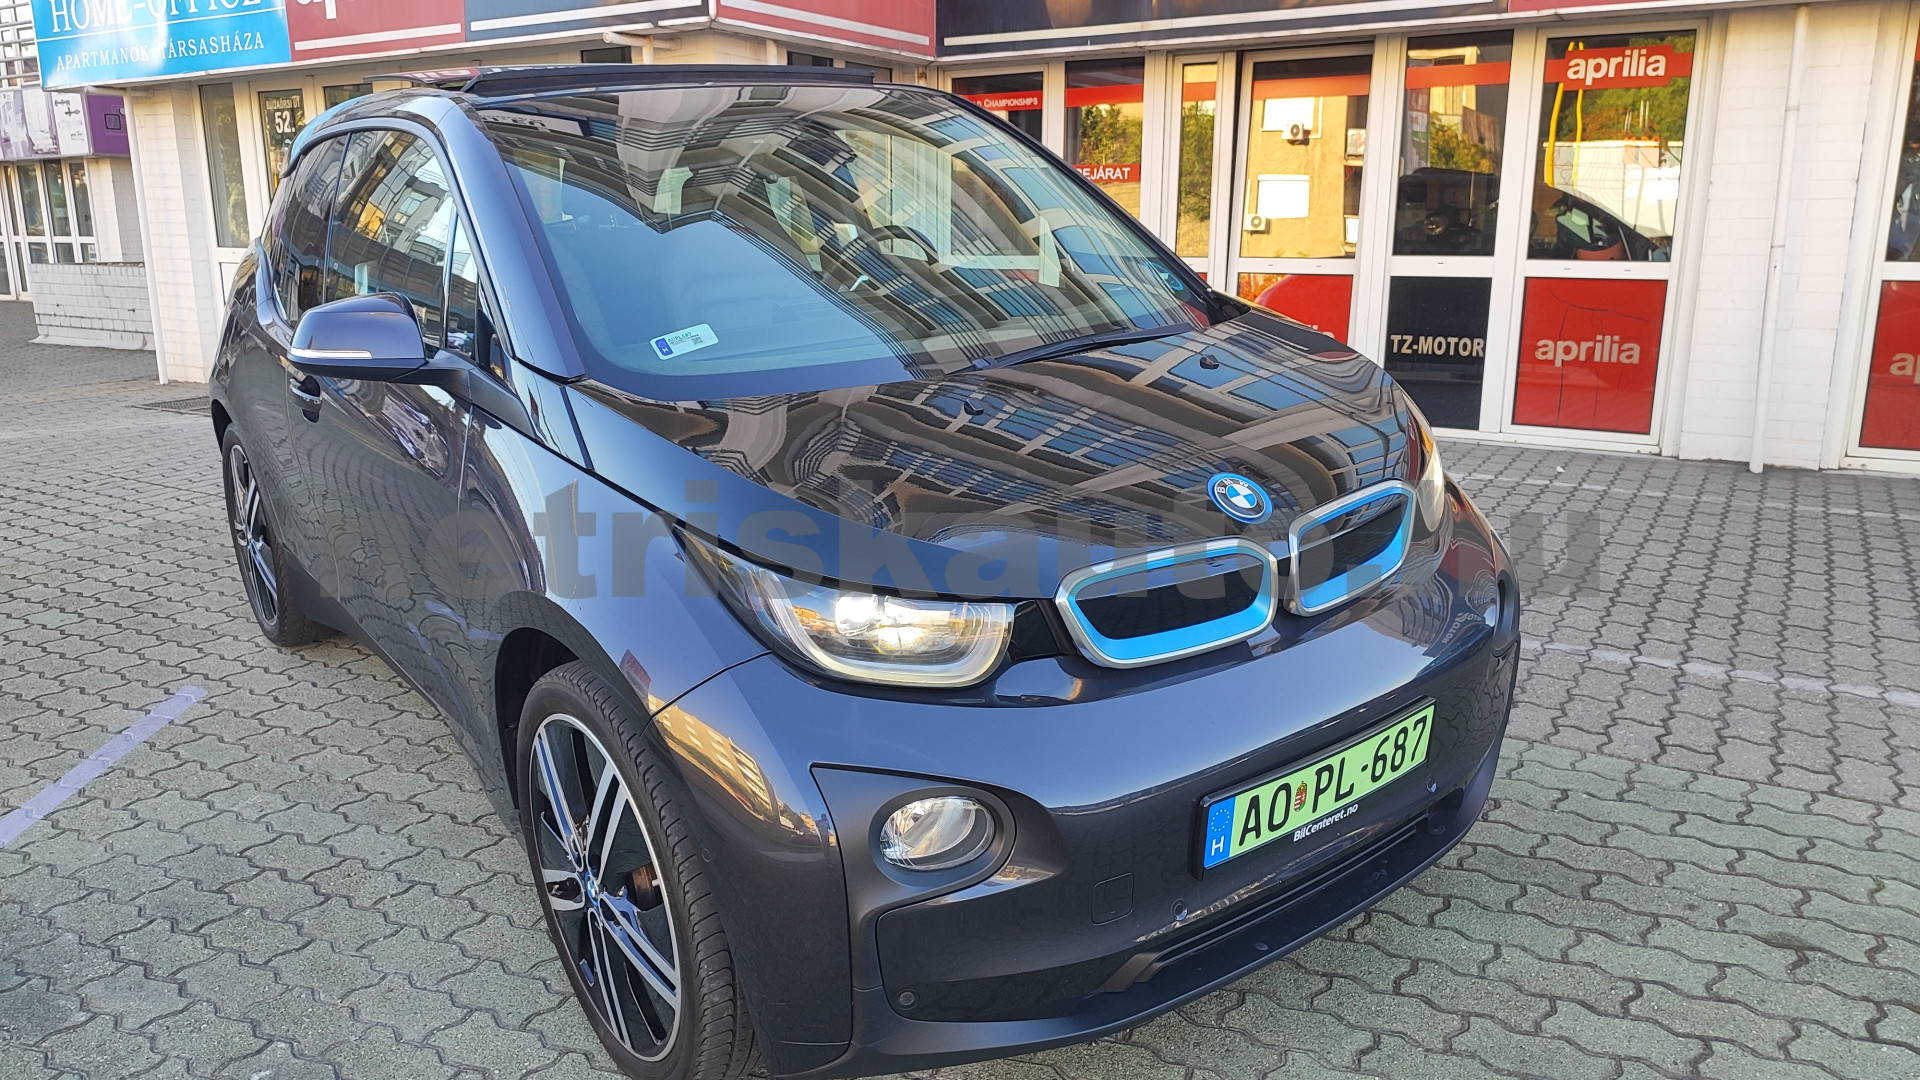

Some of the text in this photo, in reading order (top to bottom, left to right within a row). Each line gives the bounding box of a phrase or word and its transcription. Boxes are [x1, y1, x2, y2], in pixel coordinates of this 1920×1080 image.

[56, 31, 265, 72] APARTMANOK TÁRSASHÁZA
[1566, 48, 1667, 86] aprilia
[983, 97, 1039, 108] CHAMPIONSHIPS
[274, 110, 296, 133] 52.
[1390, 334, 1485, 357] TZ-MOTOR
[1534, 334, 1641, 368] aprilia
[1217, 478, 1250, 495] BMW
[1211, 835, 1225, 857] H
[1238, 782, 1293, 847] AO
[1293, 802, 1359, 843] BilCenteret.no
